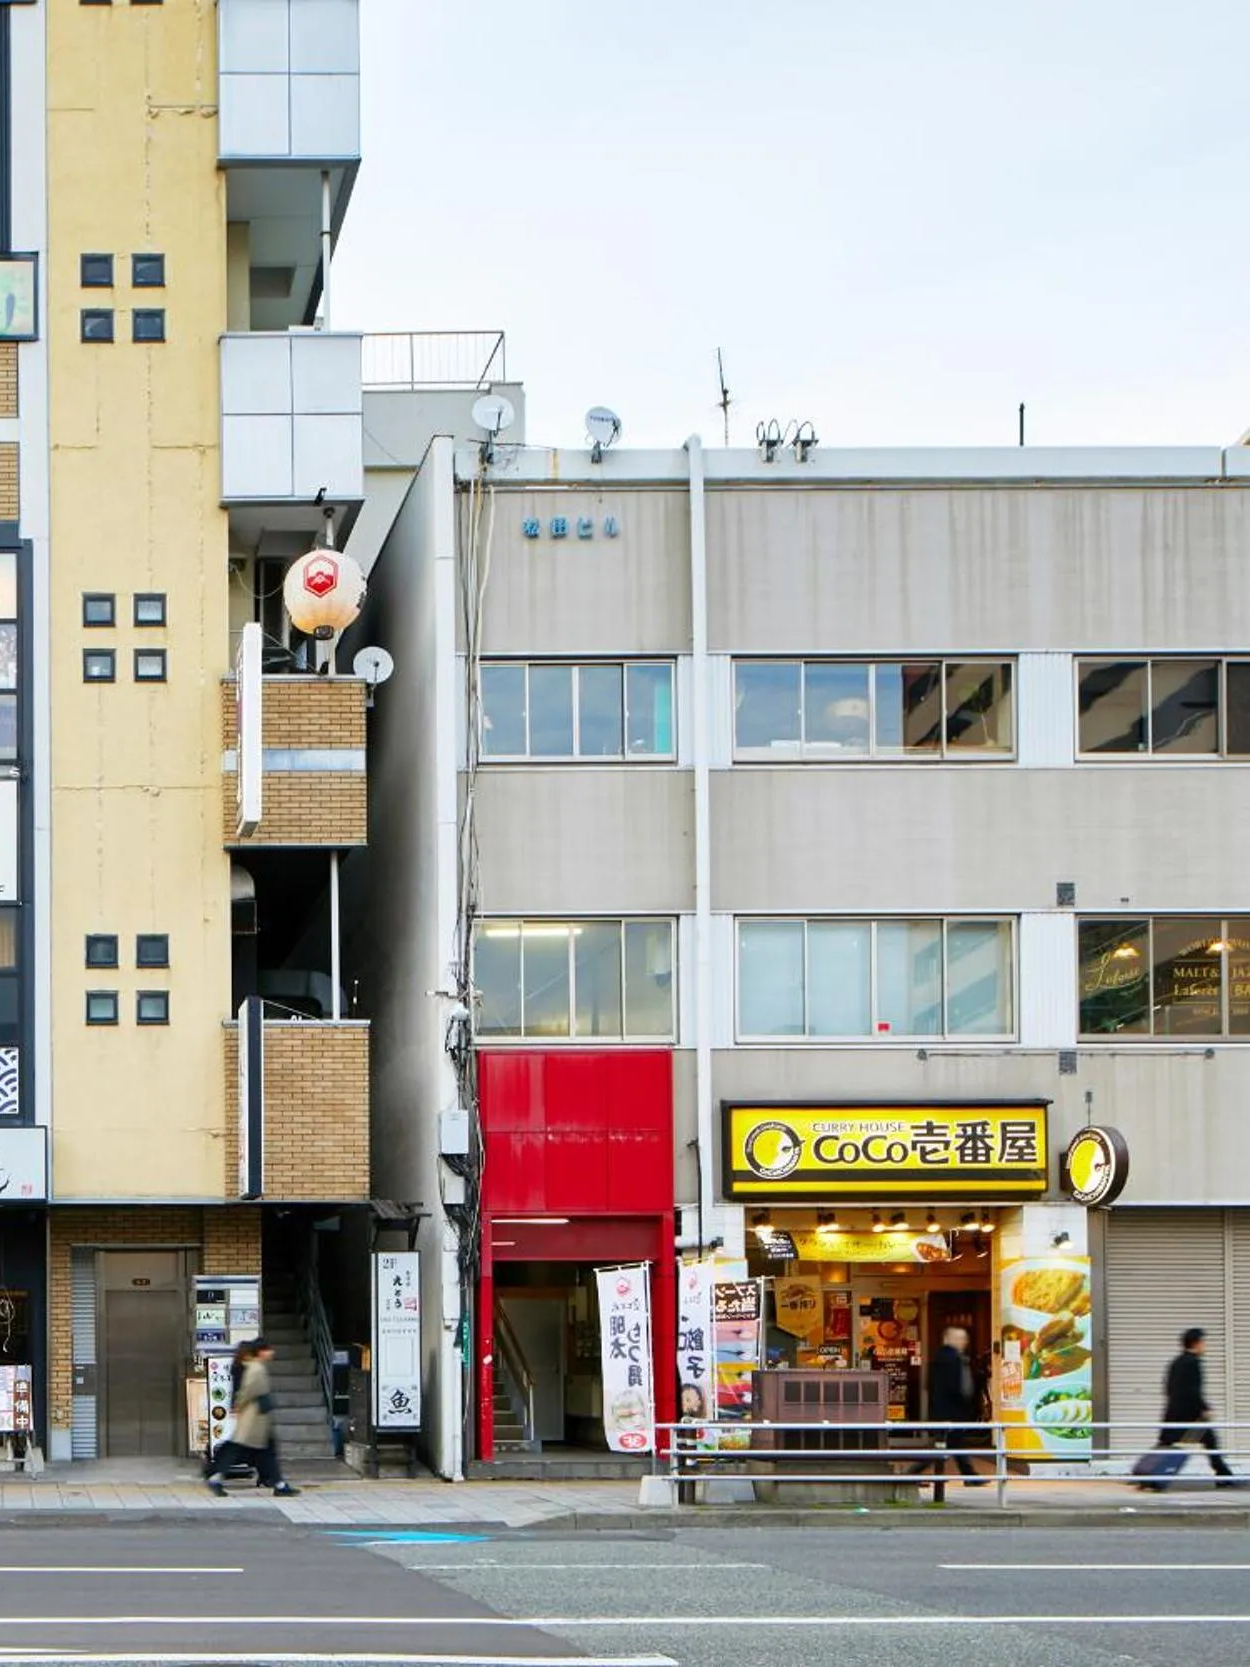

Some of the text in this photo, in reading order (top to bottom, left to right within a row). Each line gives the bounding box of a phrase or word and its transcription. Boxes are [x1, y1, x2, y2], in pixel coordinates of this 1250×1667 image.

[812, 1121, 907, 1133] CURRY HOUSE
[813, 1120, 1038, 1165] CoCo壱番屋
[16, 1380, 29, 1430] 準備中
[387, 1387, 413, 1414] 魚
